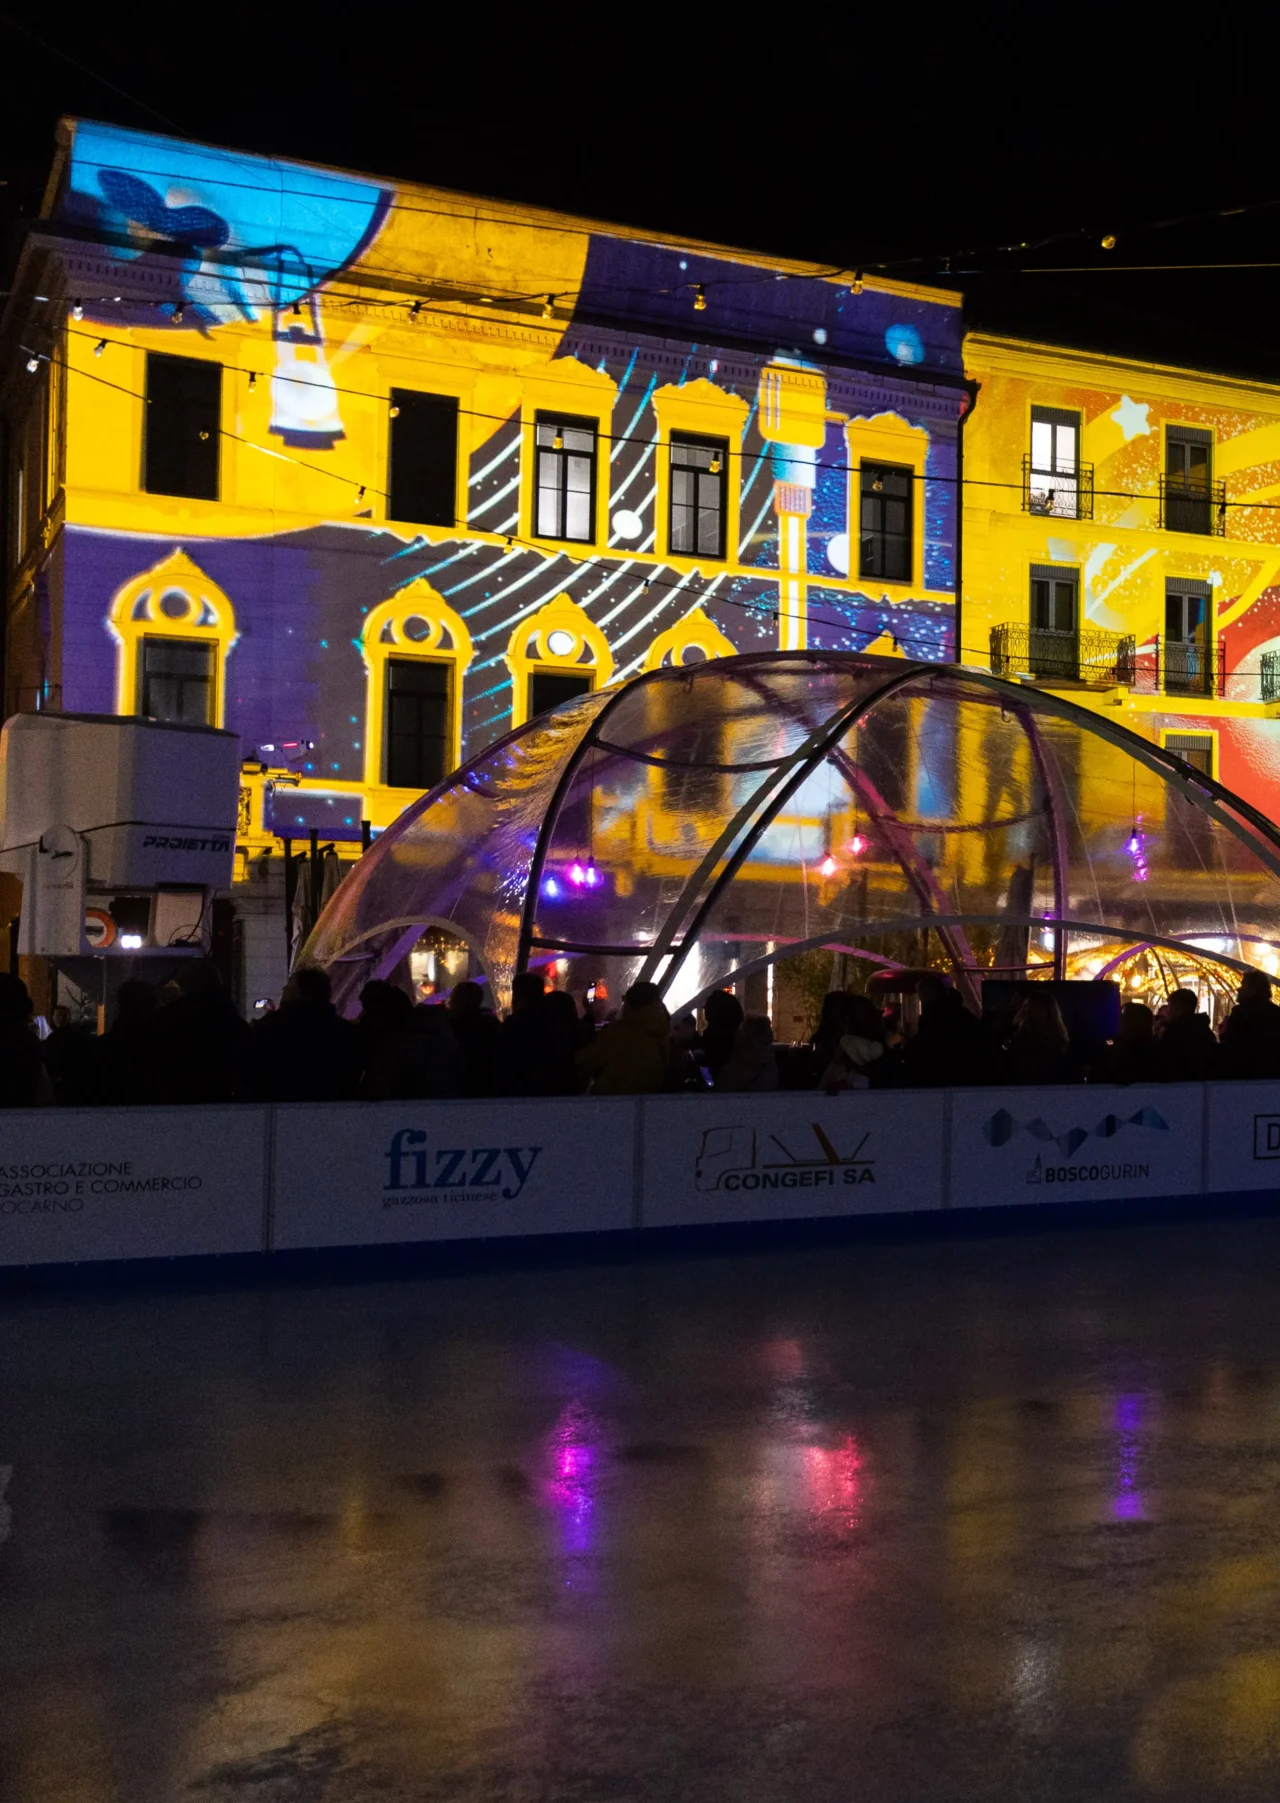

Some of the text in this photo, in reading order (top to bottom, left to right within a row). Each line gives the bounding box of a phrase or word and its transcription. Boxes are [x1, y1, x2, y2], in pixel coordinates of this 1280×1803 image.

[0, 1161, 133, 1180] ASSOCIAZIONE
[382, 1128, 544, 1201] fizzy
[1045, 1162, 1150, 1184] BOSCOGURIN
[0, 1175, 203, 1198] GASTRO E COMMERCIO
[723, 1168, 877, 1192] CONGEFI SA
[0, 1197, 85, 1214] OCARNO
